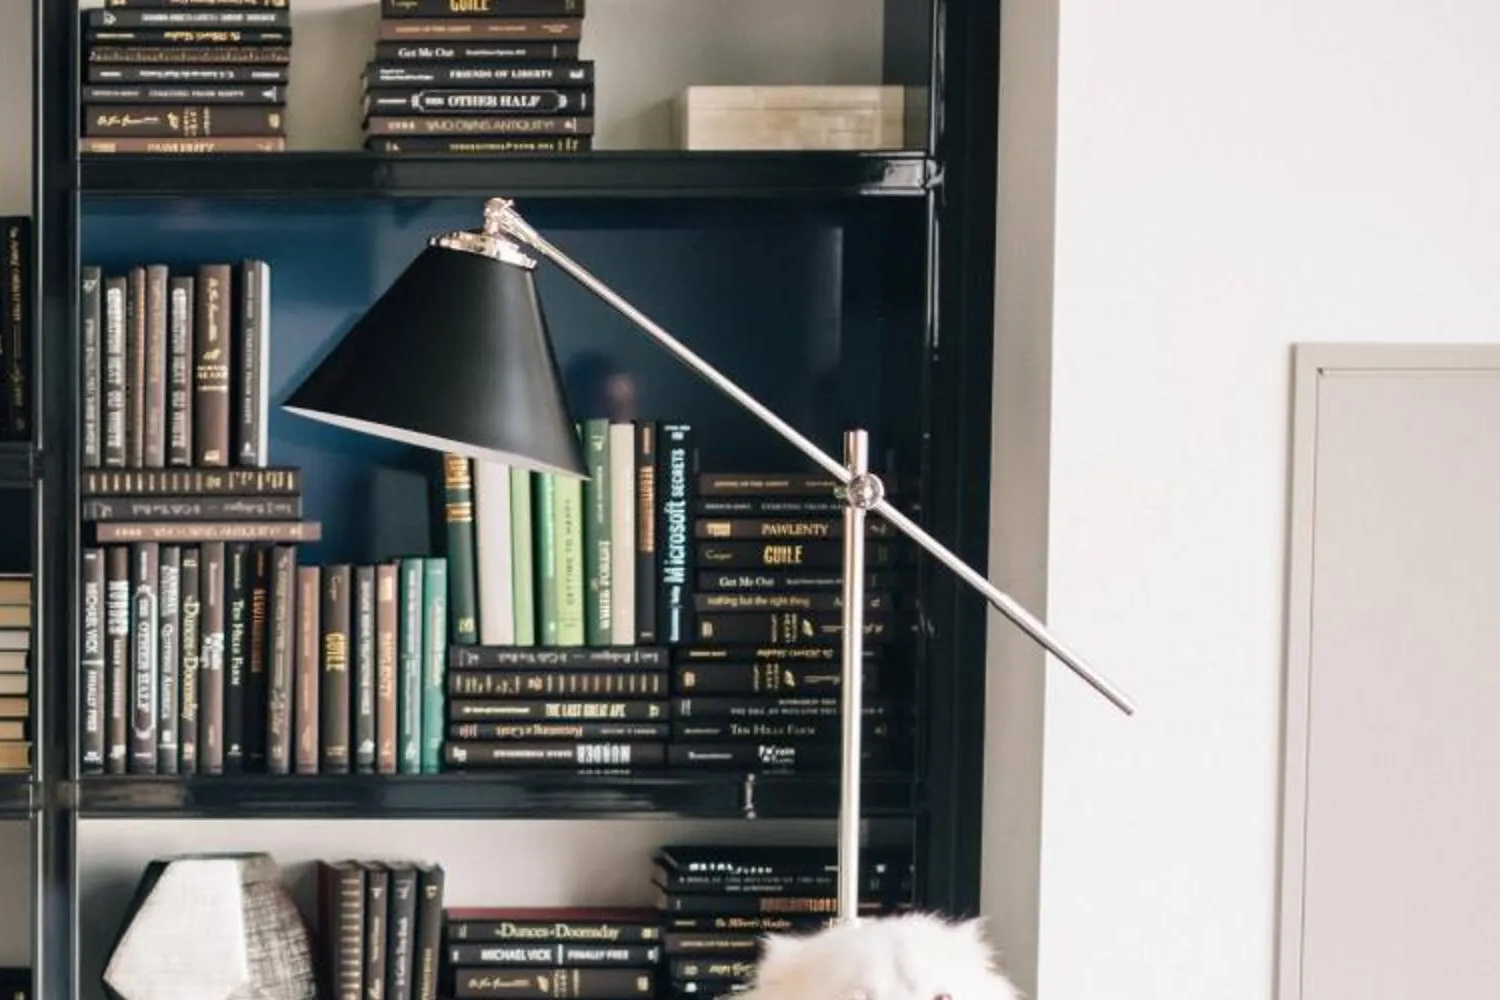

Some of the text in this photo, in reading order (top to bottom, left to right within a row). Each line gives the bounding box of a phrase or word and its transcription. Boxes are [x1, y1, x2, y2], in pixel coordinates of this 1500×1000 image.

[760, 523, 829, 537] PAWLENTY
[664, 501, 686, 583] Microsoft
[763, 544, 804, 565] GUILE
